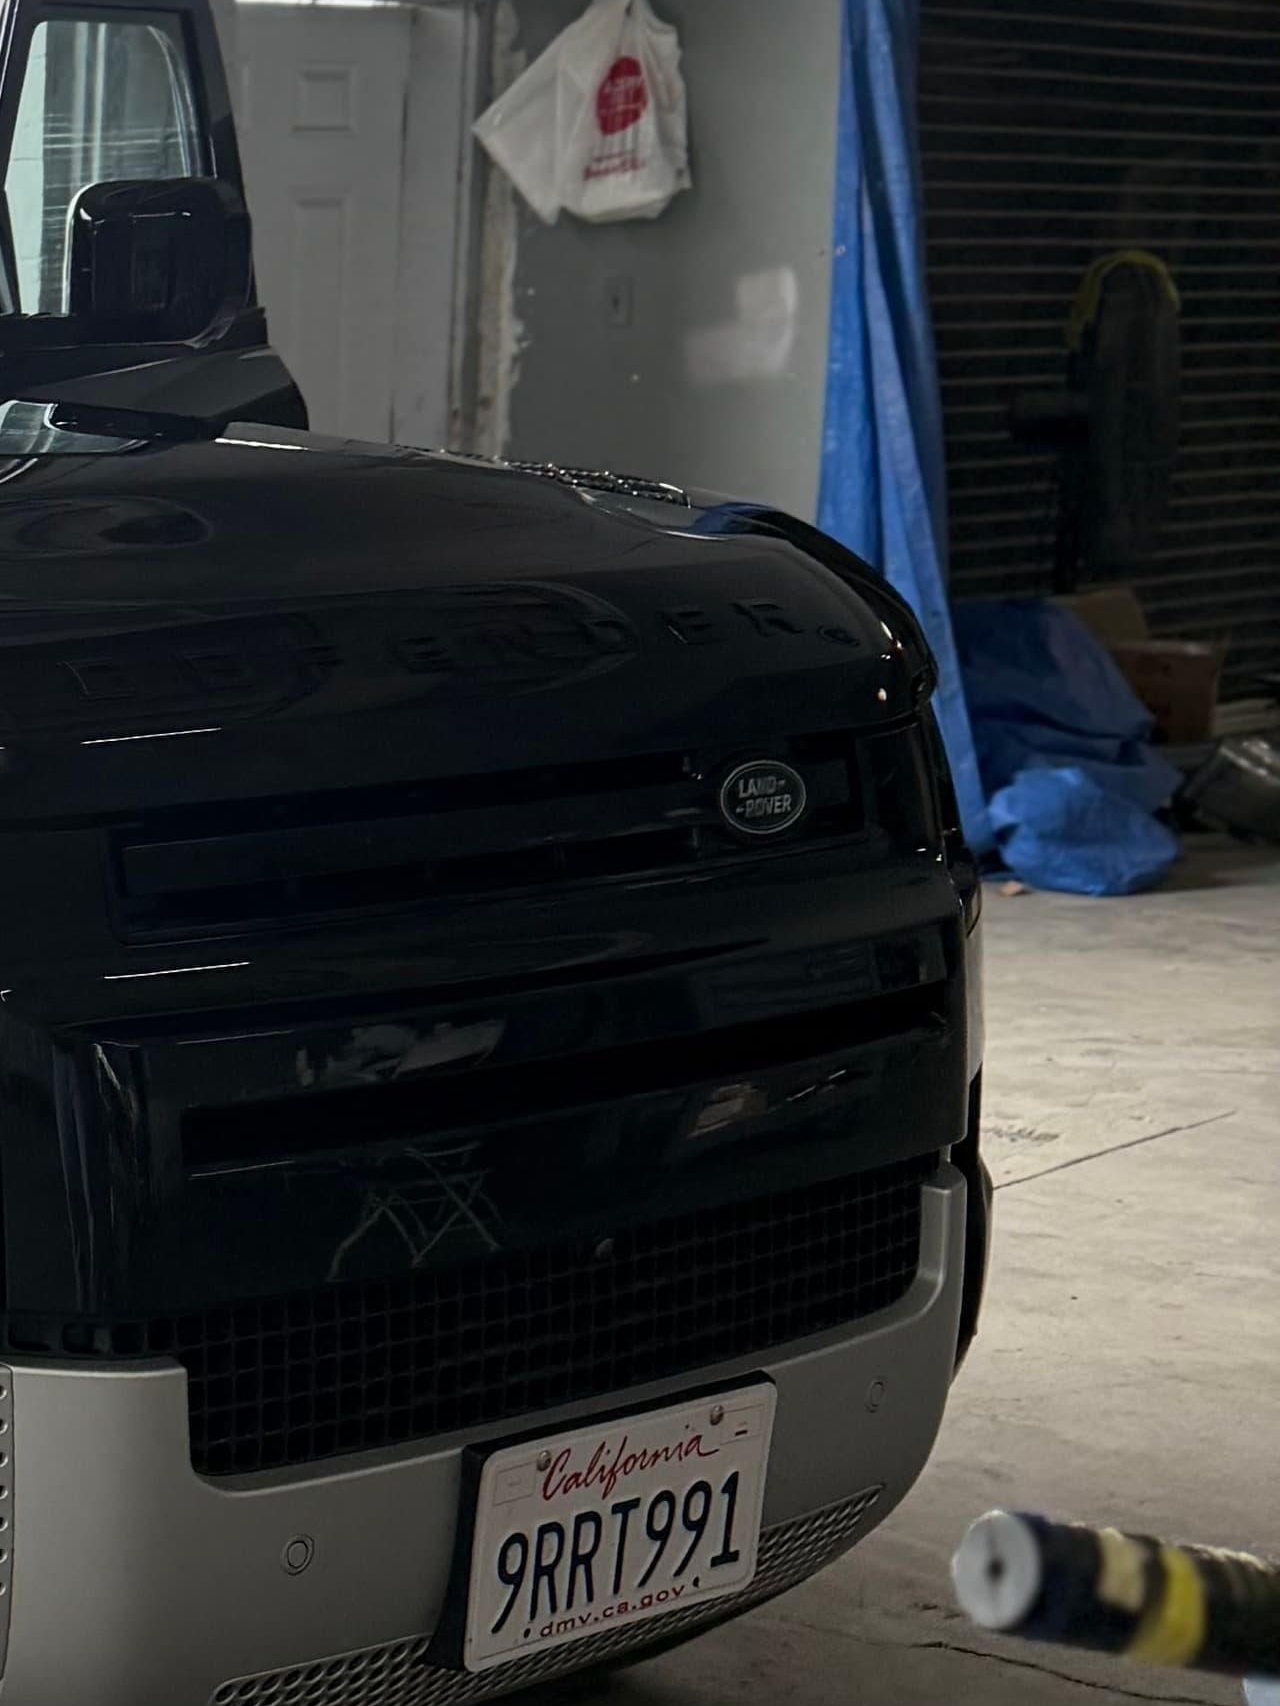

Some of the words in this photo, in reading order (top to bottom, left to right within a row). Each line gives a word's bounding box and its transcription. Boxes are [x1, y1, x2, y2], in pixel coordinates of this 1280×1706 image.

[541, 1424, 719, 1501] California
[490, 1470, 741, 1635] 9RRT991
[539, 1585, 686, 1639] dmv.ca.gov
